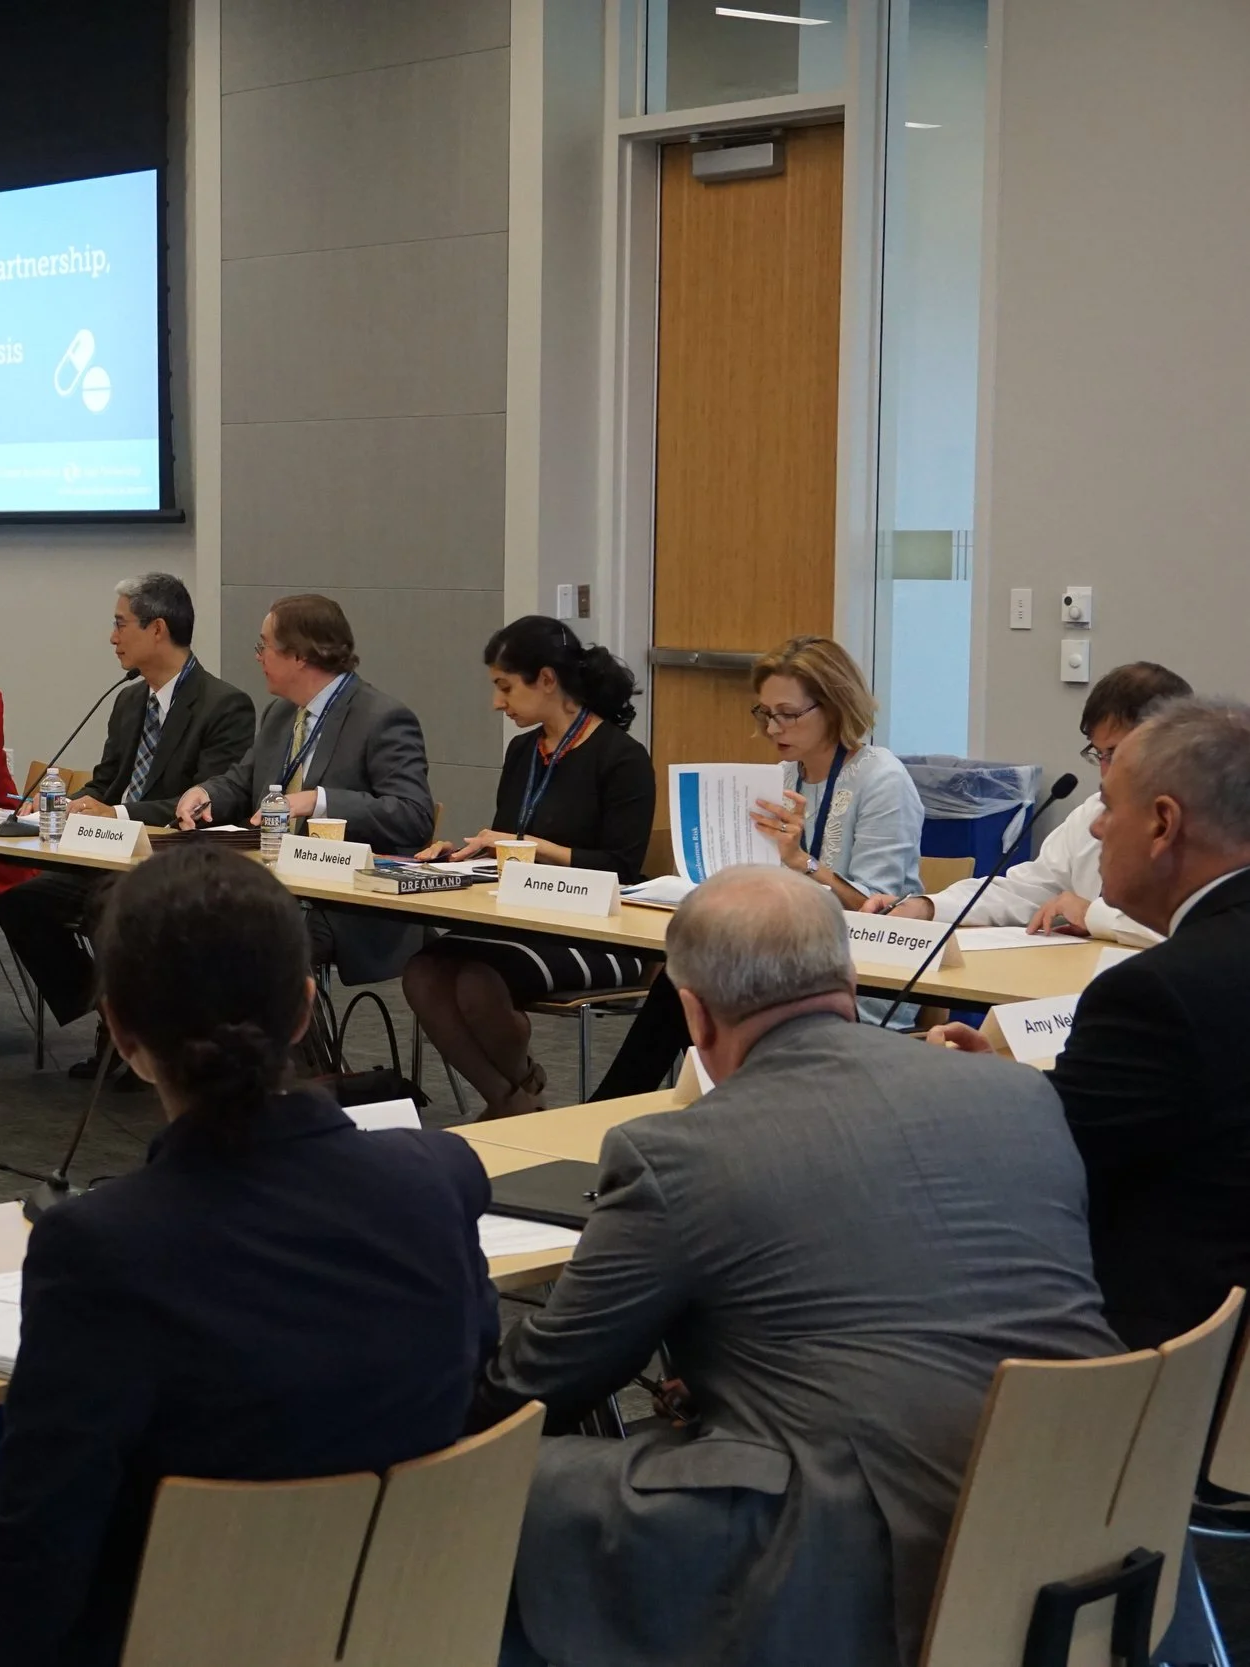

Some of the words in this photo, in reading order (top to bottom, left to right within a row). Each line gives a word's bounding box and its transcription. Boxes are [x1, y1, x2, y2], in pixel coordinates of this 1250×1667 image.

[77, 826, 94, 838] Bob
[95, 827, 125, 842] Bullock
[293, 848, 318, 861] Maha
[320, 852, 352, 866] Jweied
[401, 876, 462, 890] DREAMLAND
[524, 876, 554, 891] Anne
[557, 881, 588, 896] Dunn
[848, 926, 885, 943] tchell
[887, 931, 933, 951] Berger
[1025, 1019, 1053, 1034] Amy
